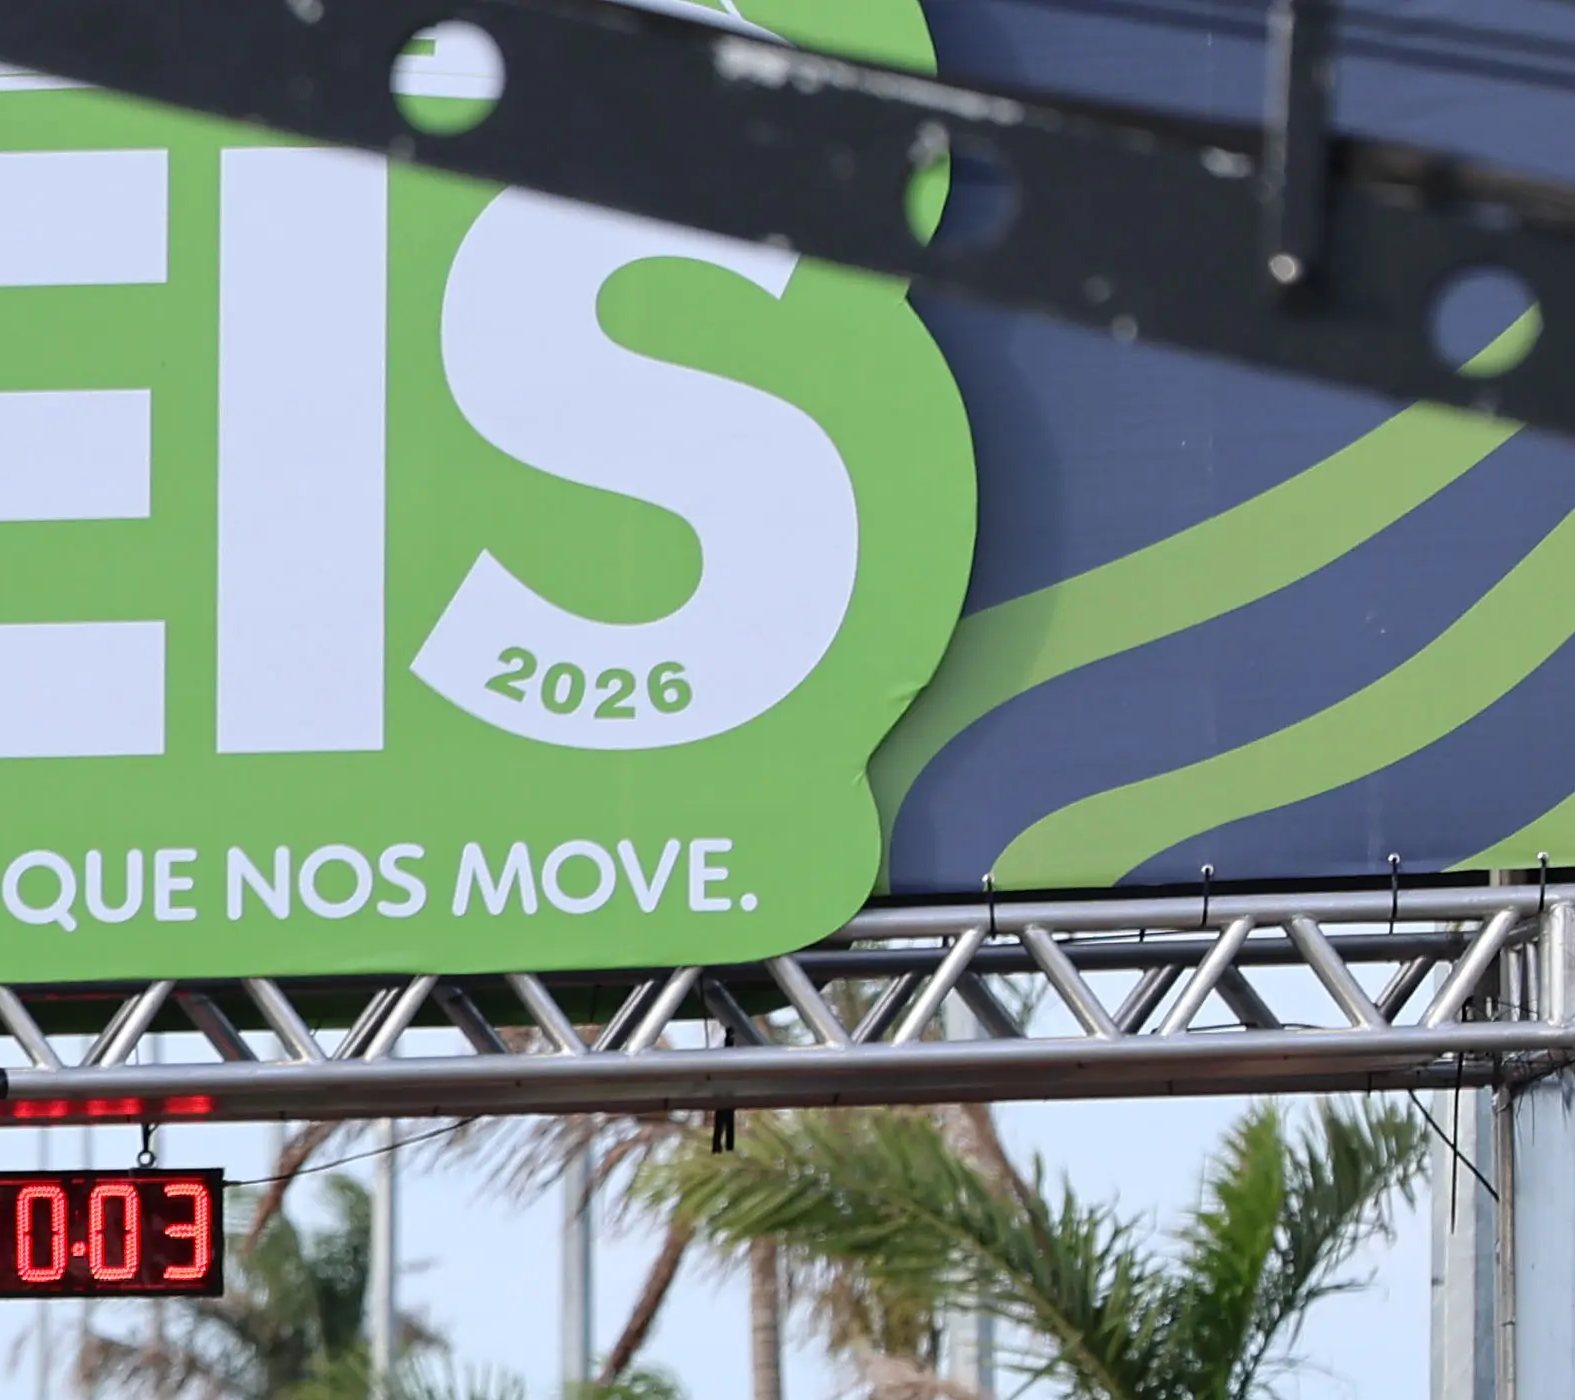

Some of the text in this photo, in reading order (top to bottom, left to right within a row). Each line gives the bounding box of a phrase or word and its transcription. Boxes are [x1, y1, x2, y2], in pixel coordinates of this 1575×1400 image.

[484, 646, 693, 720] 2026
[0, 844, 199, 933] QUE
[226, 841, 429, 922] NOS
[450, 836, 759, 916] MOVE.
